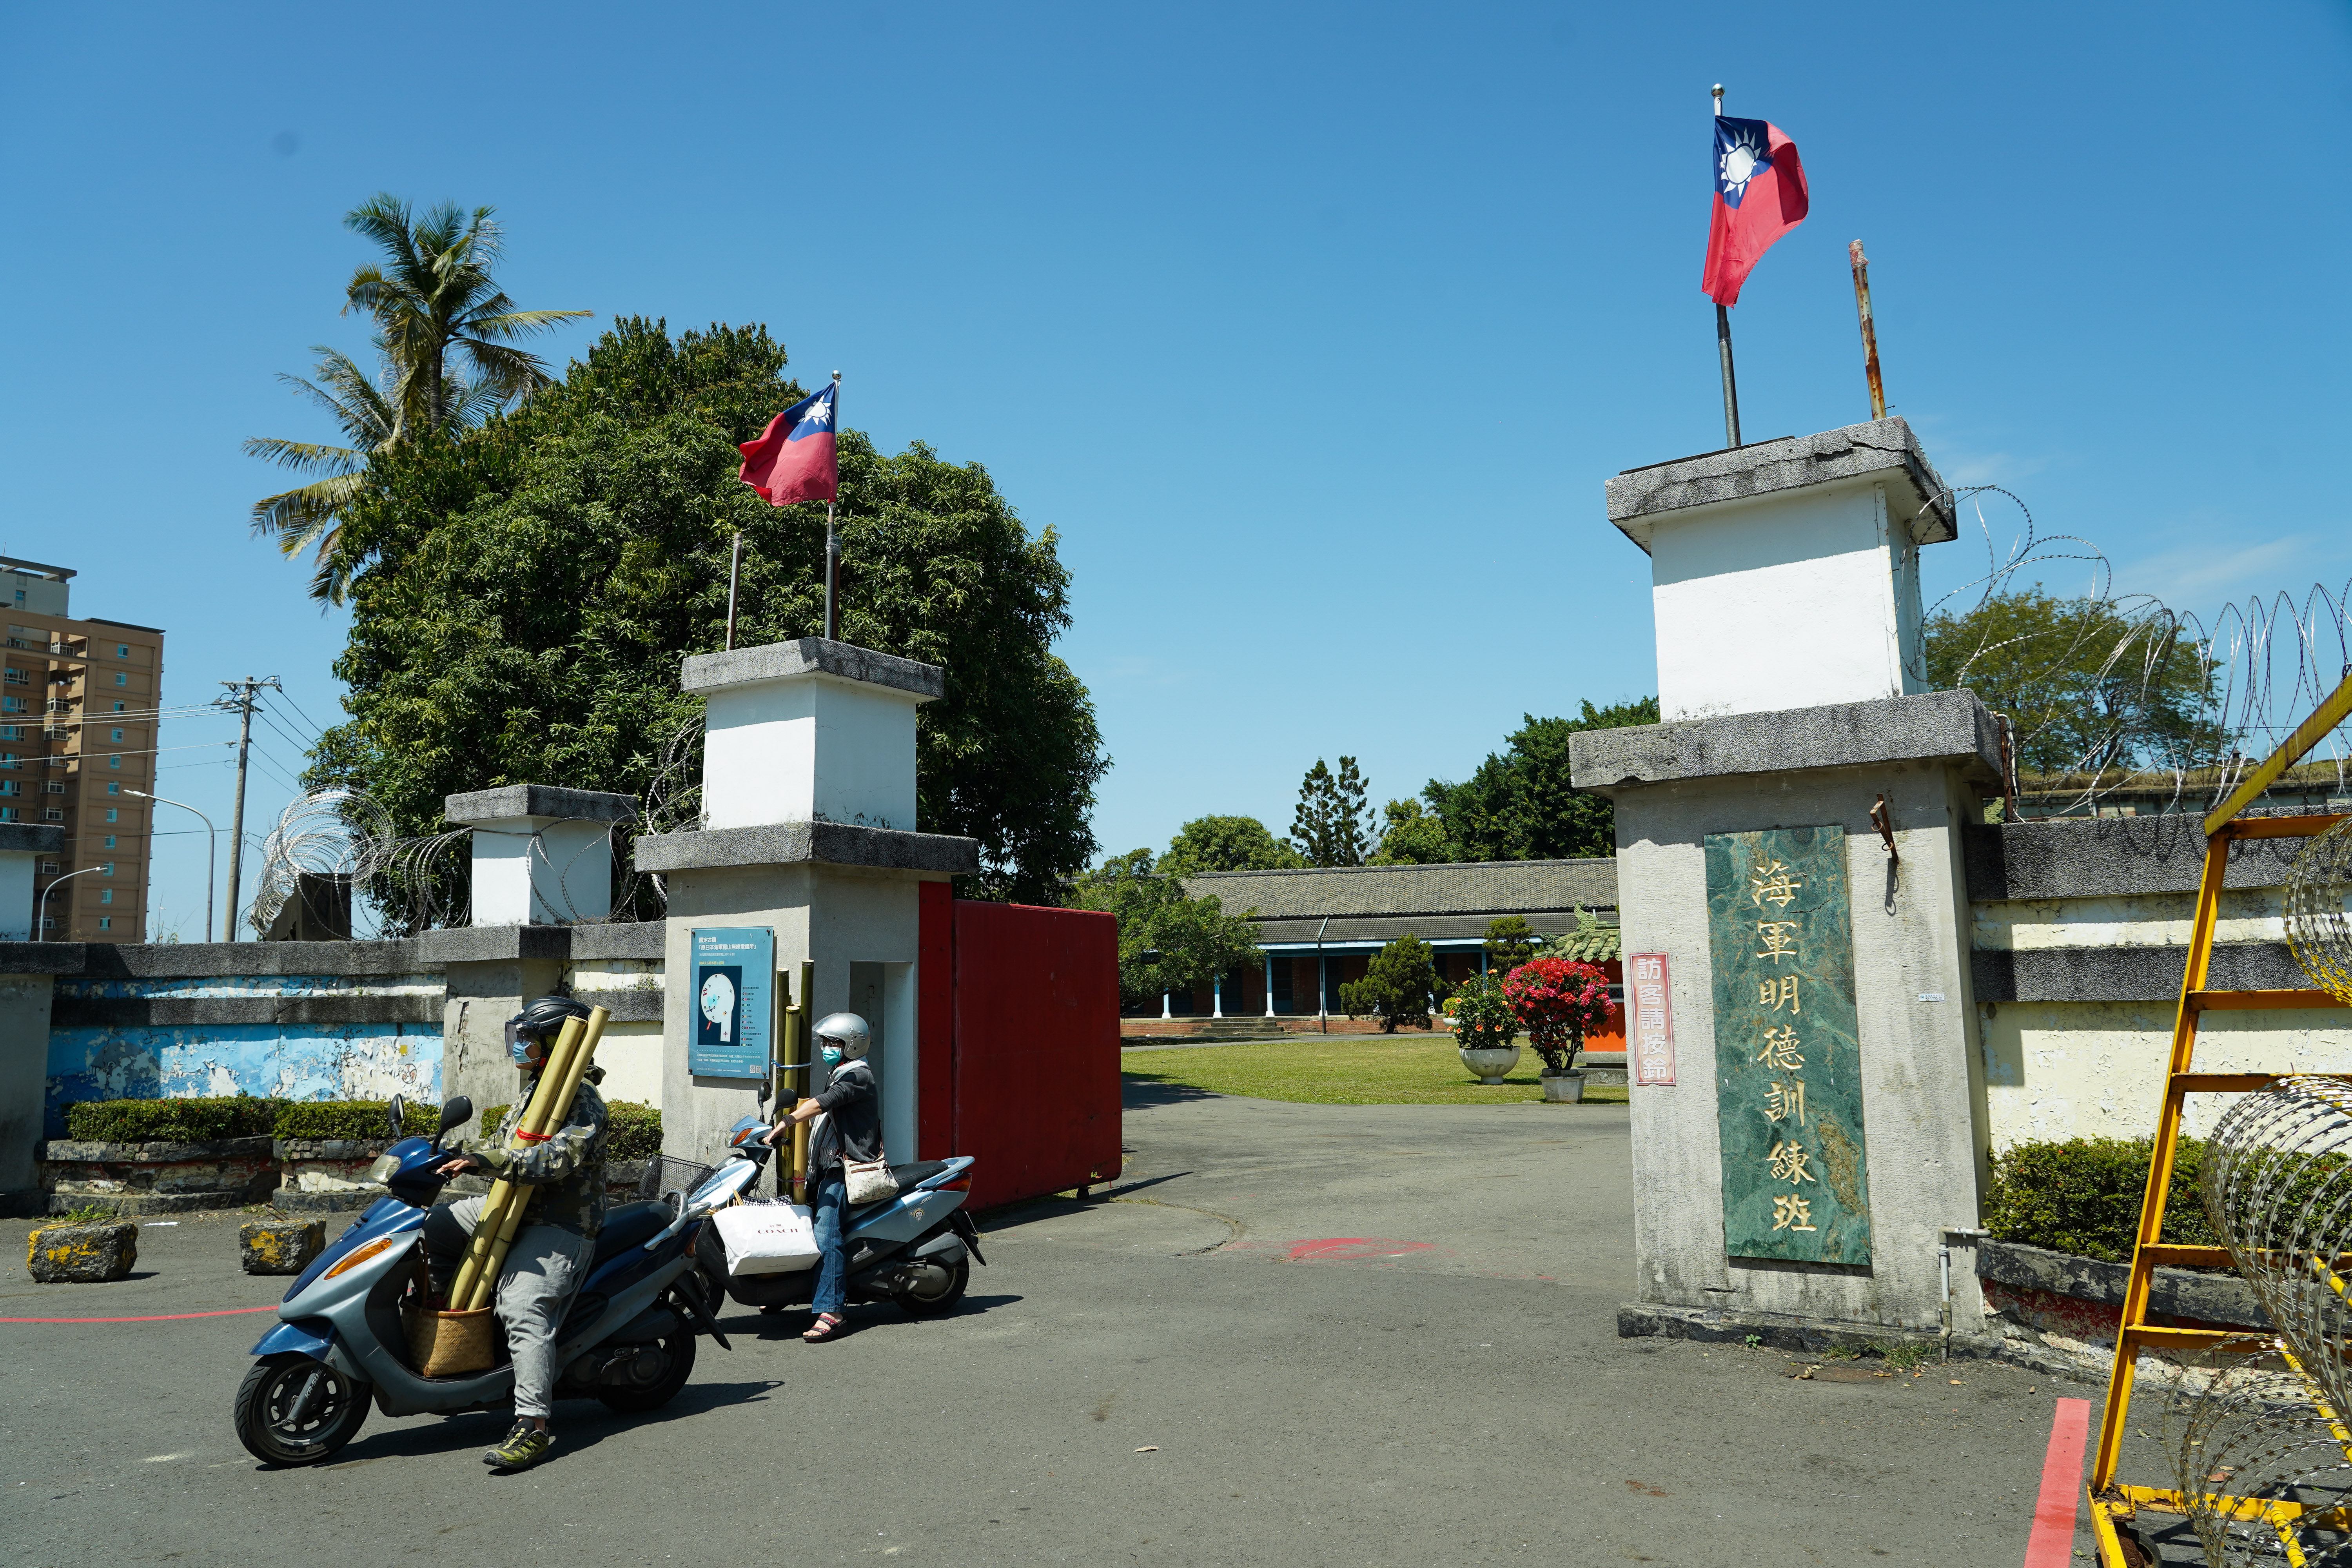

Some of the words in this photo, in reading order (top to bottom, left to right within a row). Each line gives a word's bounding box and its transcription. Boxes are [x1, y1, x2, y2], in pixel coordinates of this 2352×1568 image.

[1637, 958, 1667, 1079] 訪客請按鈴
[1751, 860, 1817, 1232] 海軍明德訓練班
